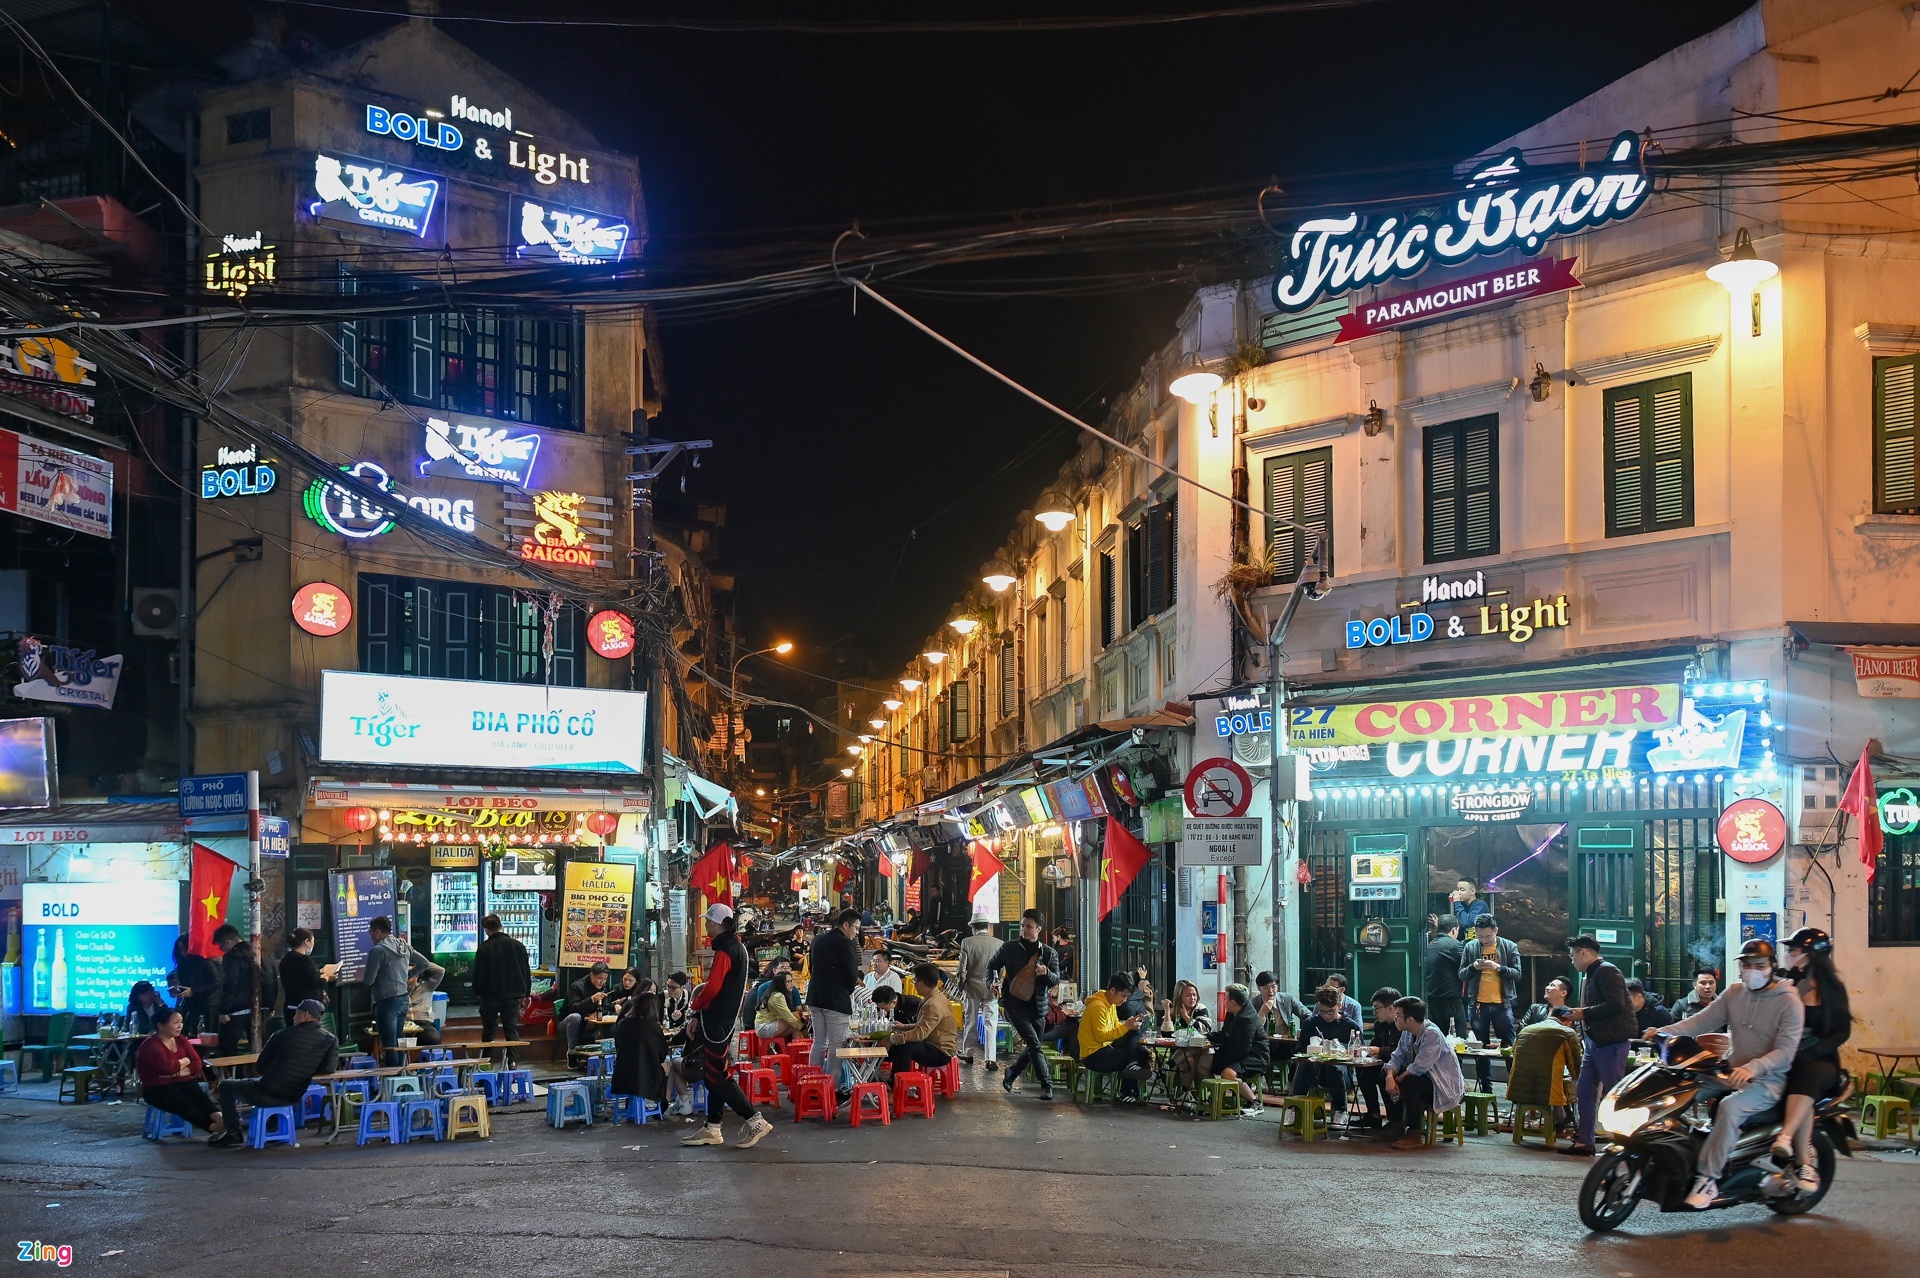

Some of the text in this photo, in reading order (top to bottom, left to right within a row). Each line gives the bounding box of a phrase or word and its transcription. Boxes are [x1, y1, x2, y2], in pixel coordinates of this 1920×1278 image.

[451, 95, 512, 131] Hanoi
[366, 104, 590, 185] BOLD & Light
[345, 164, 431, 211] Tiger
[359, 209, 417, 230] CRYSTAL
[1277, 139, 1648, 302] Trúc Bạch
[550, 211, 623, 254] Tiger
[206, 252, 276, 297] Light
[1366, 268, 1541, 325] PARAMOUNT BEER
[456, 424, 534, 465] Tiger
[218, 443, 256, 466] Hanoi
[202, 465, 276, 499] BOLD
[465, 465, 521, 482] CRYSTAL
[546, 537, 568, 548] BIA
[521, 544, 592, 566] SAIGON
[1422, 570, 1487, 603] Hanoi
[1345, 594, 1570, 649] BOLD & Light
[601, 640, 630, 651] SAIGON
[49, 645, 120, 686] Tiger
[1855, 656, 1920, 679] HANOI BEER
[58, 687, 109, 703] CRYSTAL
[1292, 686, 1669, 738] 27 CORNER
[350, 714, 421, 747] Tiger
[472, 708, 596, 737] BIA PHỐ CỔ
[1215, 711, 1272, 737] BOLD
[1292, 727, 1335, 741] TẠ HIỆN
[1305, 744, 1371, 764] TUBORG
[202, 779, 224, 791] PHỐ
[1562, 769, 1577, 782] 27
[183, 789, 244, 811] LƯƠNG NGỌC QUYẾN
[491, 794, 538, 809] BÉO
[1451, 792, 1532, 810] STRONGBOW
[1192, 822, 1204, 830] QUÉT
[1234, 823, 1246, 831] HOẠT
[1246, 822, 1259, 831] ĐỘNG
[1464, 812, 1490, 822] APPLE
[52, 826, 89, 842] BÉO
[268, 822, 280, 833] PHỐ
[261, 834, 286, 853] TẠ HIỆN
[434, 847, 475, 858] HALIDA
[1209, 843, 1237, 854] NGOẠI LỆ
[1731, 841, 1770, 852] SAIGON
[1210, 854, 1235, 863] Except
[582, 880, 616, 889] HALIDA
[359, 893, 370, 901] Bia
[588, 892, 609, 902] PHỐ
[42, 903, 80, 917] BOLD
